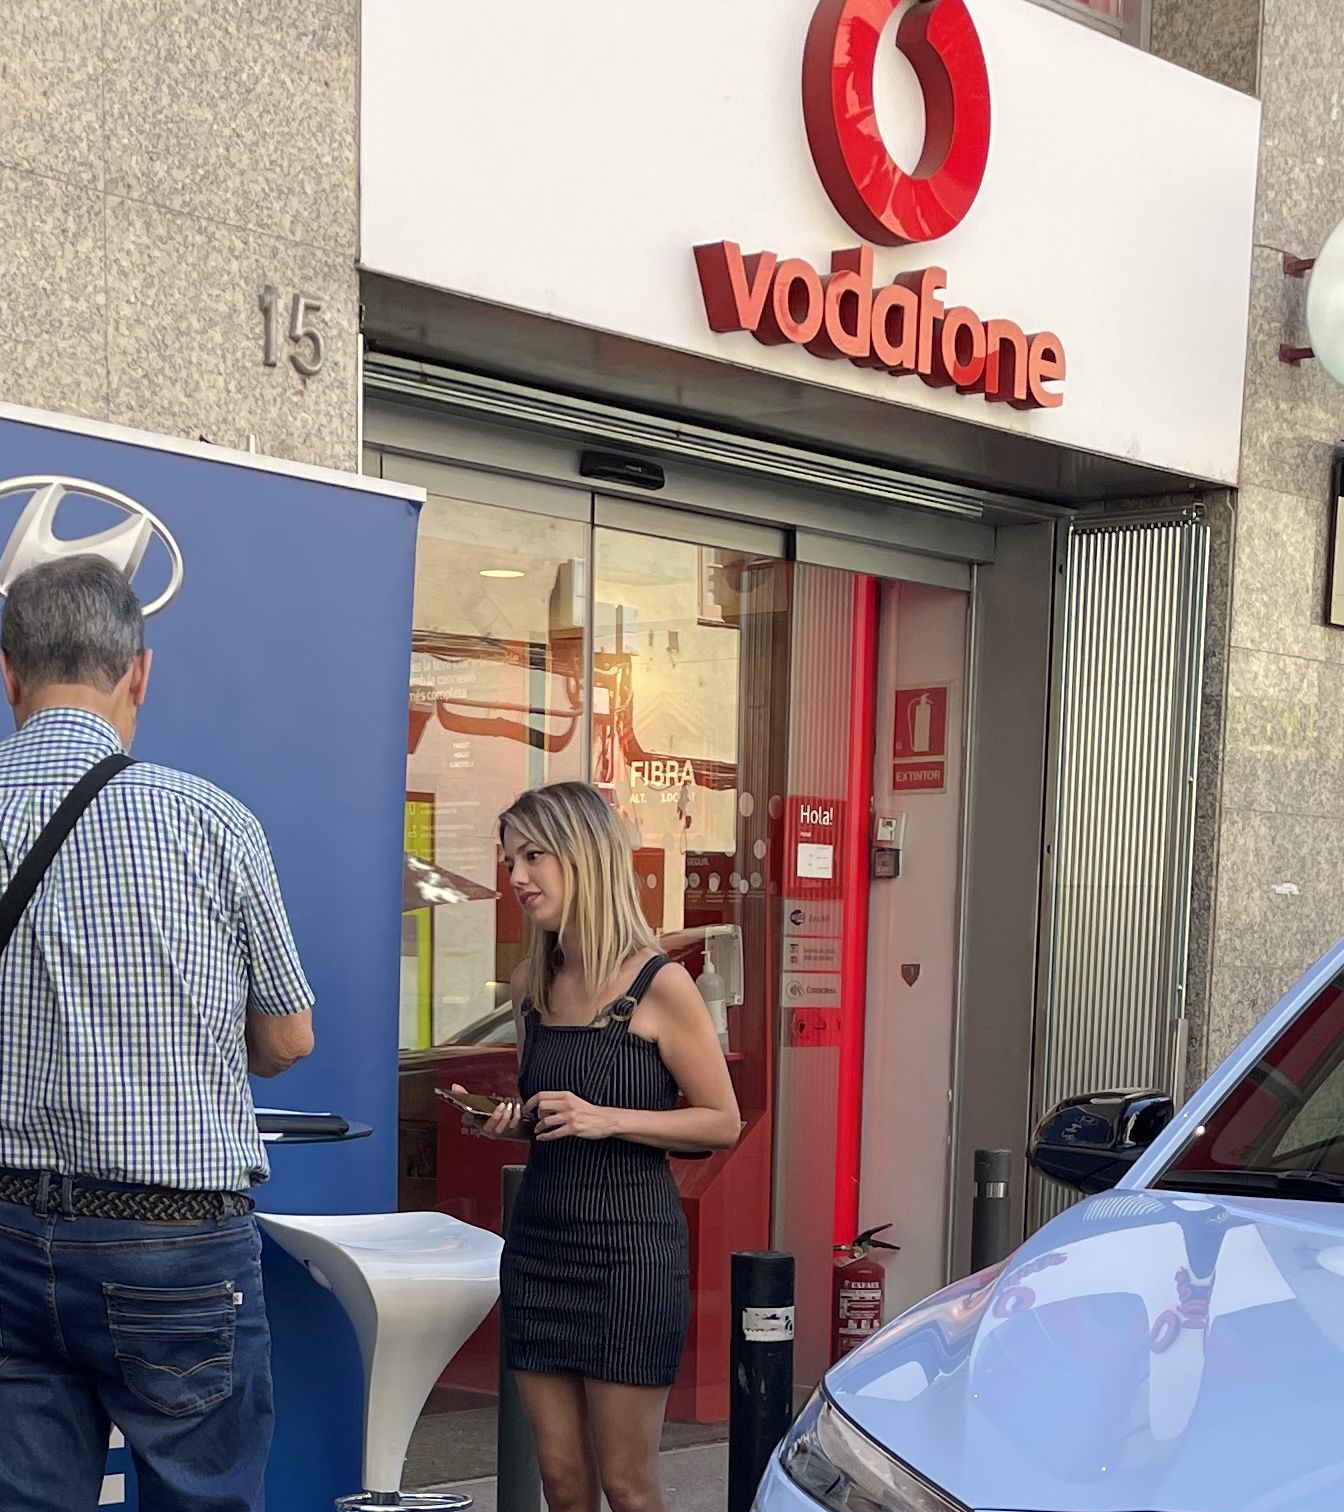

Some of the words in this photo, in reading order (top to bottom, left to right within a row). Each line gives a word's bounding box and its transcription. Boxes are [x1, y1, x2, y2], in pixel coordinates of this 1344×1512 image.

[258, 284, 328, 377] 15
[694, 241, 1066, 409] vodafone
[630, 760, 697, 788] FIBRA
[896, 769, 941, 783] EXTINTOR
[799, 804, 834, 826] Hola!
